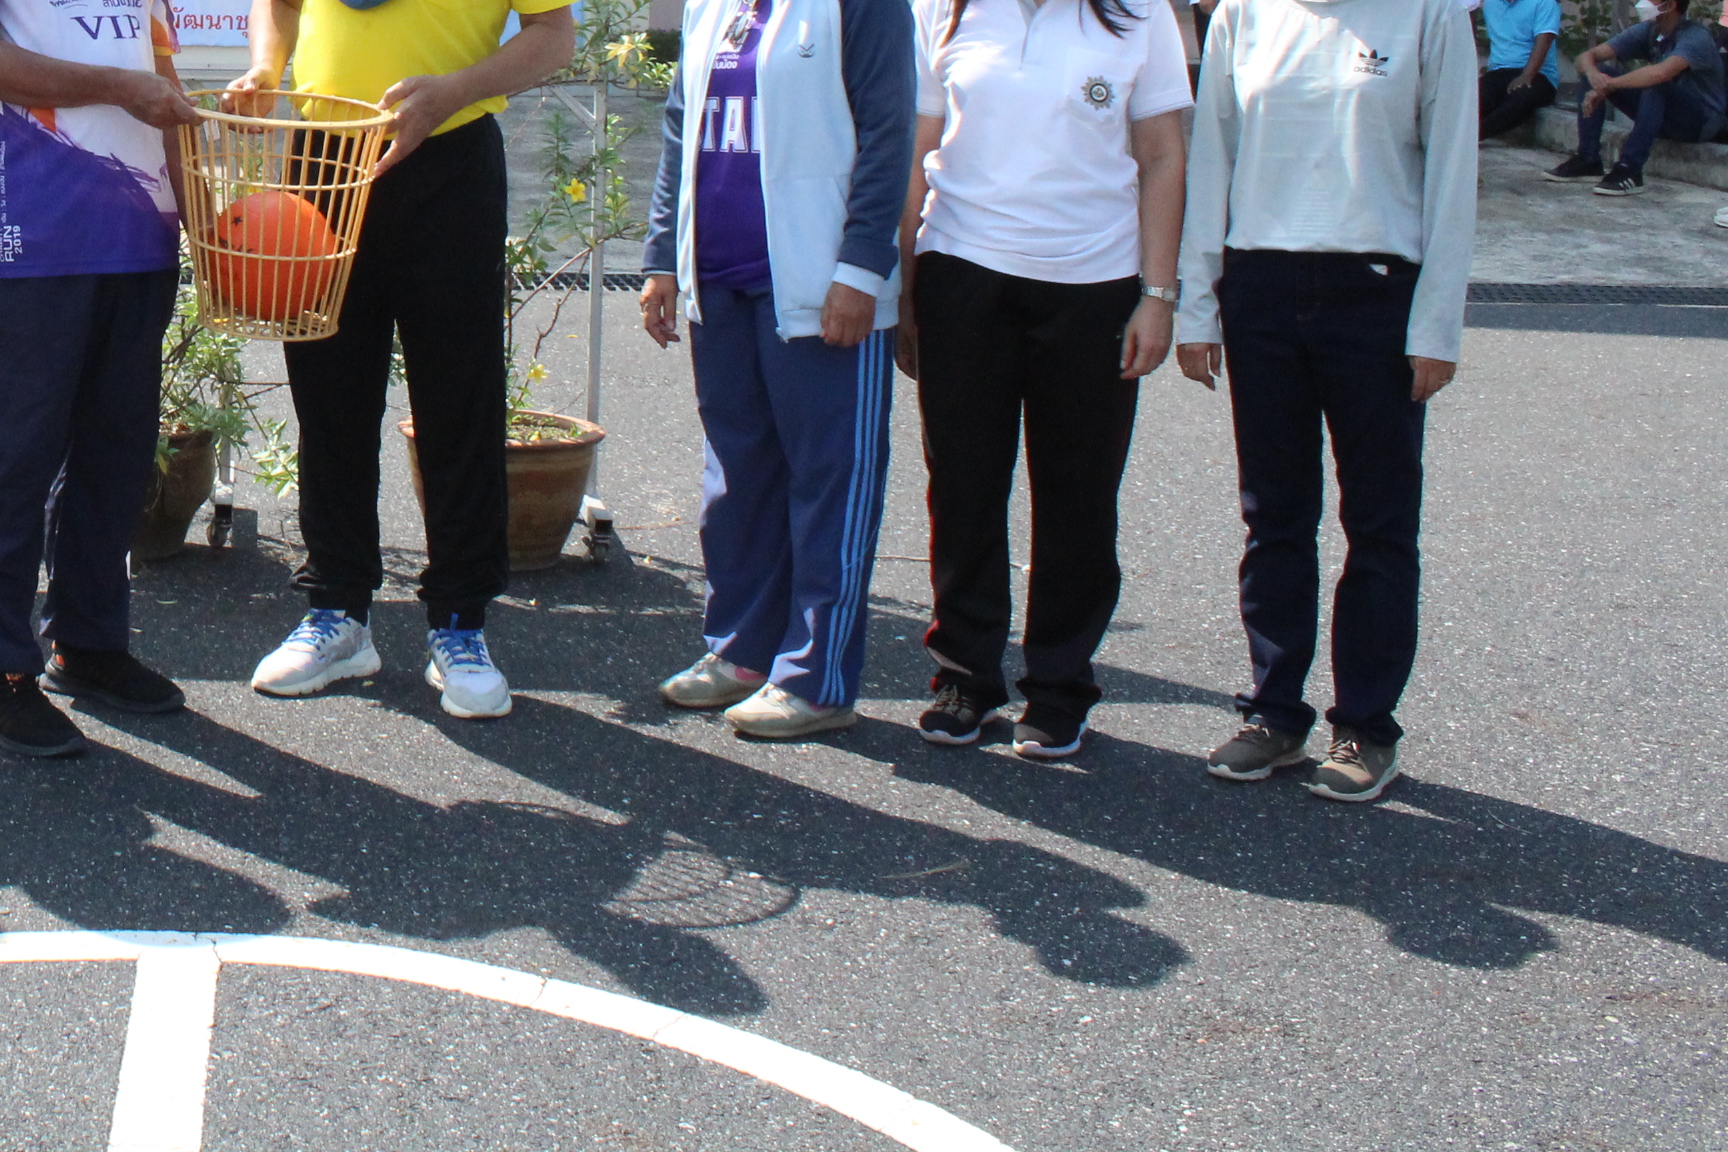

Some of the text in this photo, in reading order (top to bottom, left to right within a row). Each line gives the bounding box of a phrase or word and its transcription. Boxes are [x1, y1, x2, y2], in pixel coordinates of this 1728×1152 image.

[70, 14, 141, 40] VIP
[1353, 66, 1388, 77] adidas
[3, 225, 15, 262] RUN
[13, 225, 23, 254] 2019
